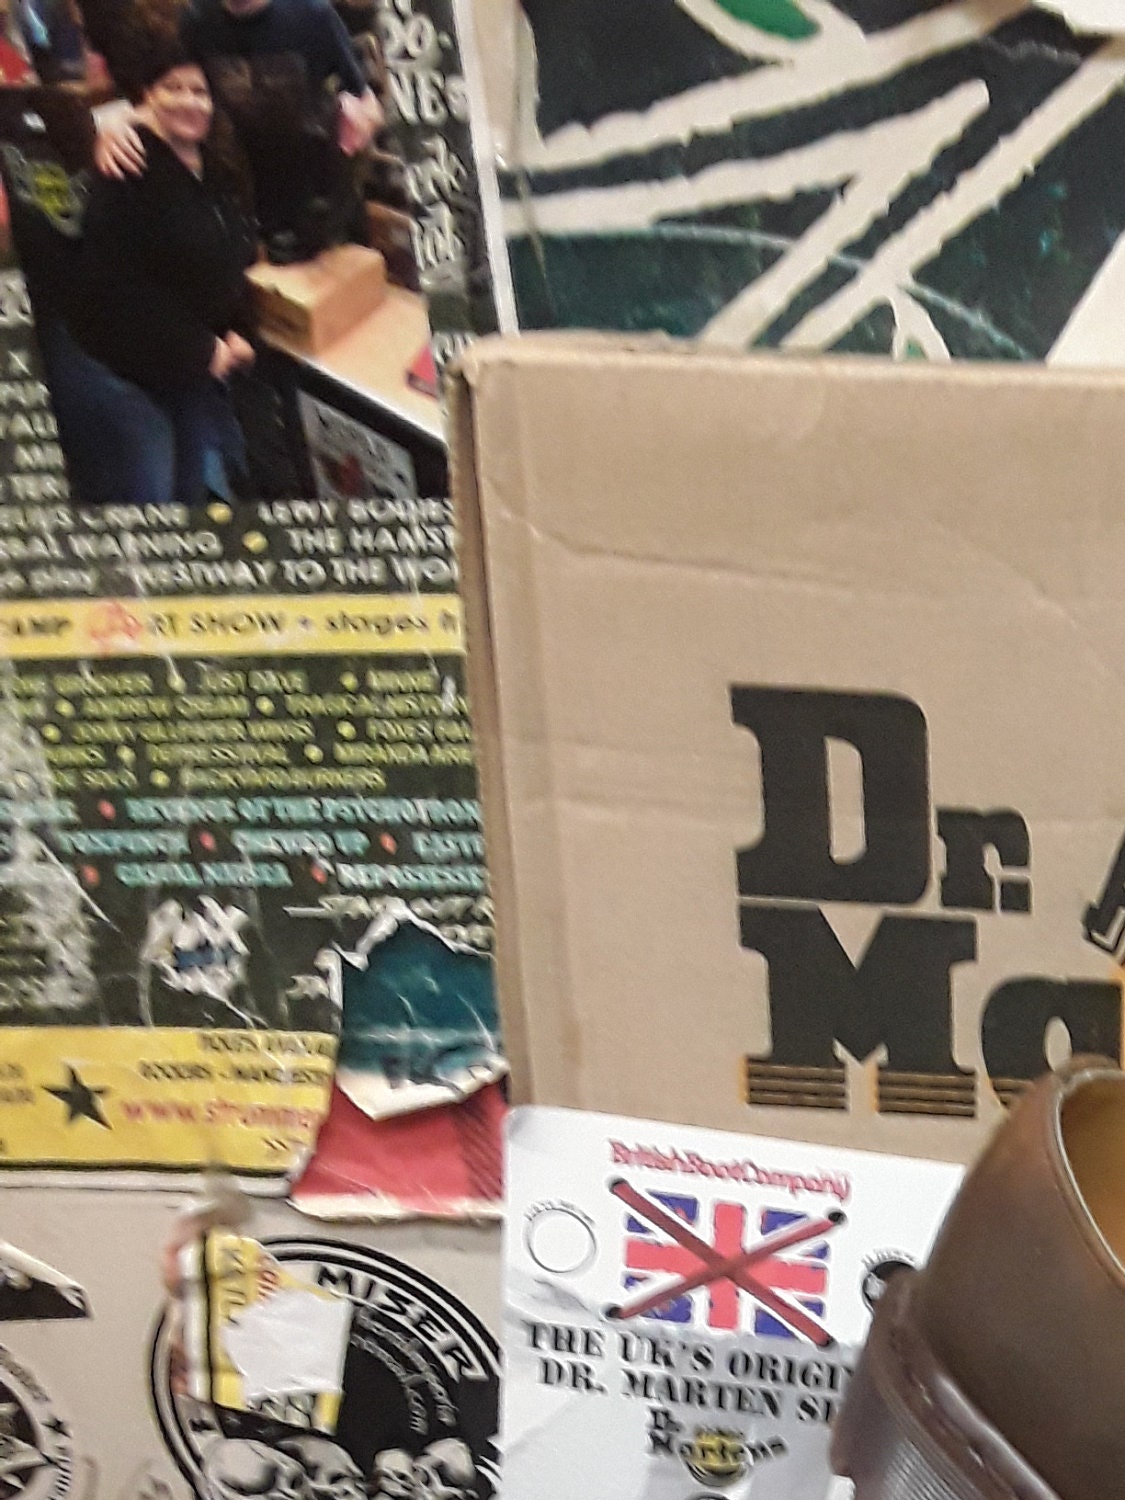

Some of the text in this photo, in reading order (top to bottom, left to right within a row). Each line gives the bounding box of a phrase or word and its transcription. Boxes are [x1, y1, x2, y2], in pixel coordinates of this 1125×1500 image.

[69, 530, 224, 560] WARNING
[286, 528, 342, 553] THE
[282, 560, 327, 587] TO
[331, 558, 387, 587] THE
[188, 609, 287, 637] SHOW
[608, 1137, 851, 1201] BritishBootCompany
[524, 1320, 603, 1360] THE
[618, 1327, 715, 1375] UK'S
[538, 1357, 608, 1395] DR.
[622, 1369, 782, 1420] MARTEN
